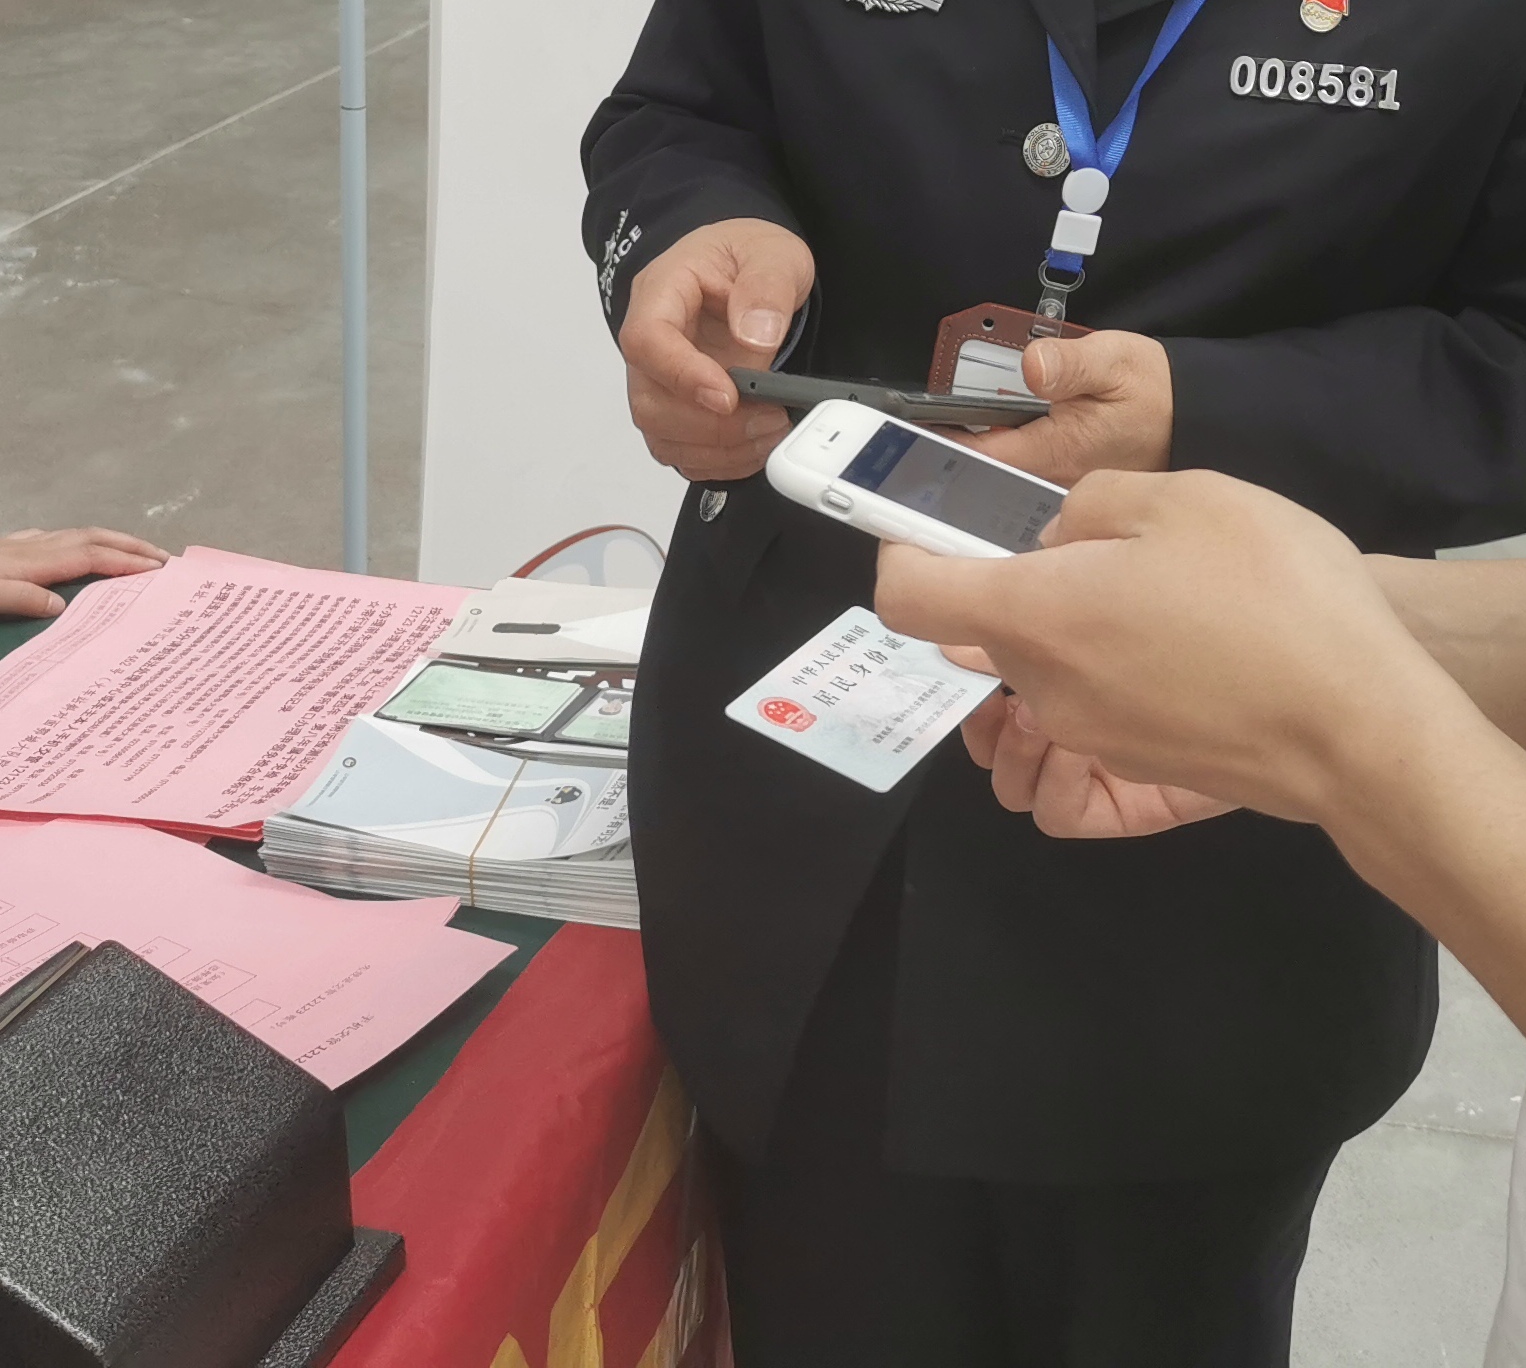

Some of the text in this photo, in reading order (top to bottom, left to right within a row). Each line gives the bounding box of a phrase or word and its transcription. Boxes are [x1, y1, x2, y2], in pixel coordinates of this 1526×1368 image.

[1230, 55, 1400, 110] 008581
[791, 624, 870, 688] 中华人民共和国
[812, 634, 906, 708] 居民身份证
